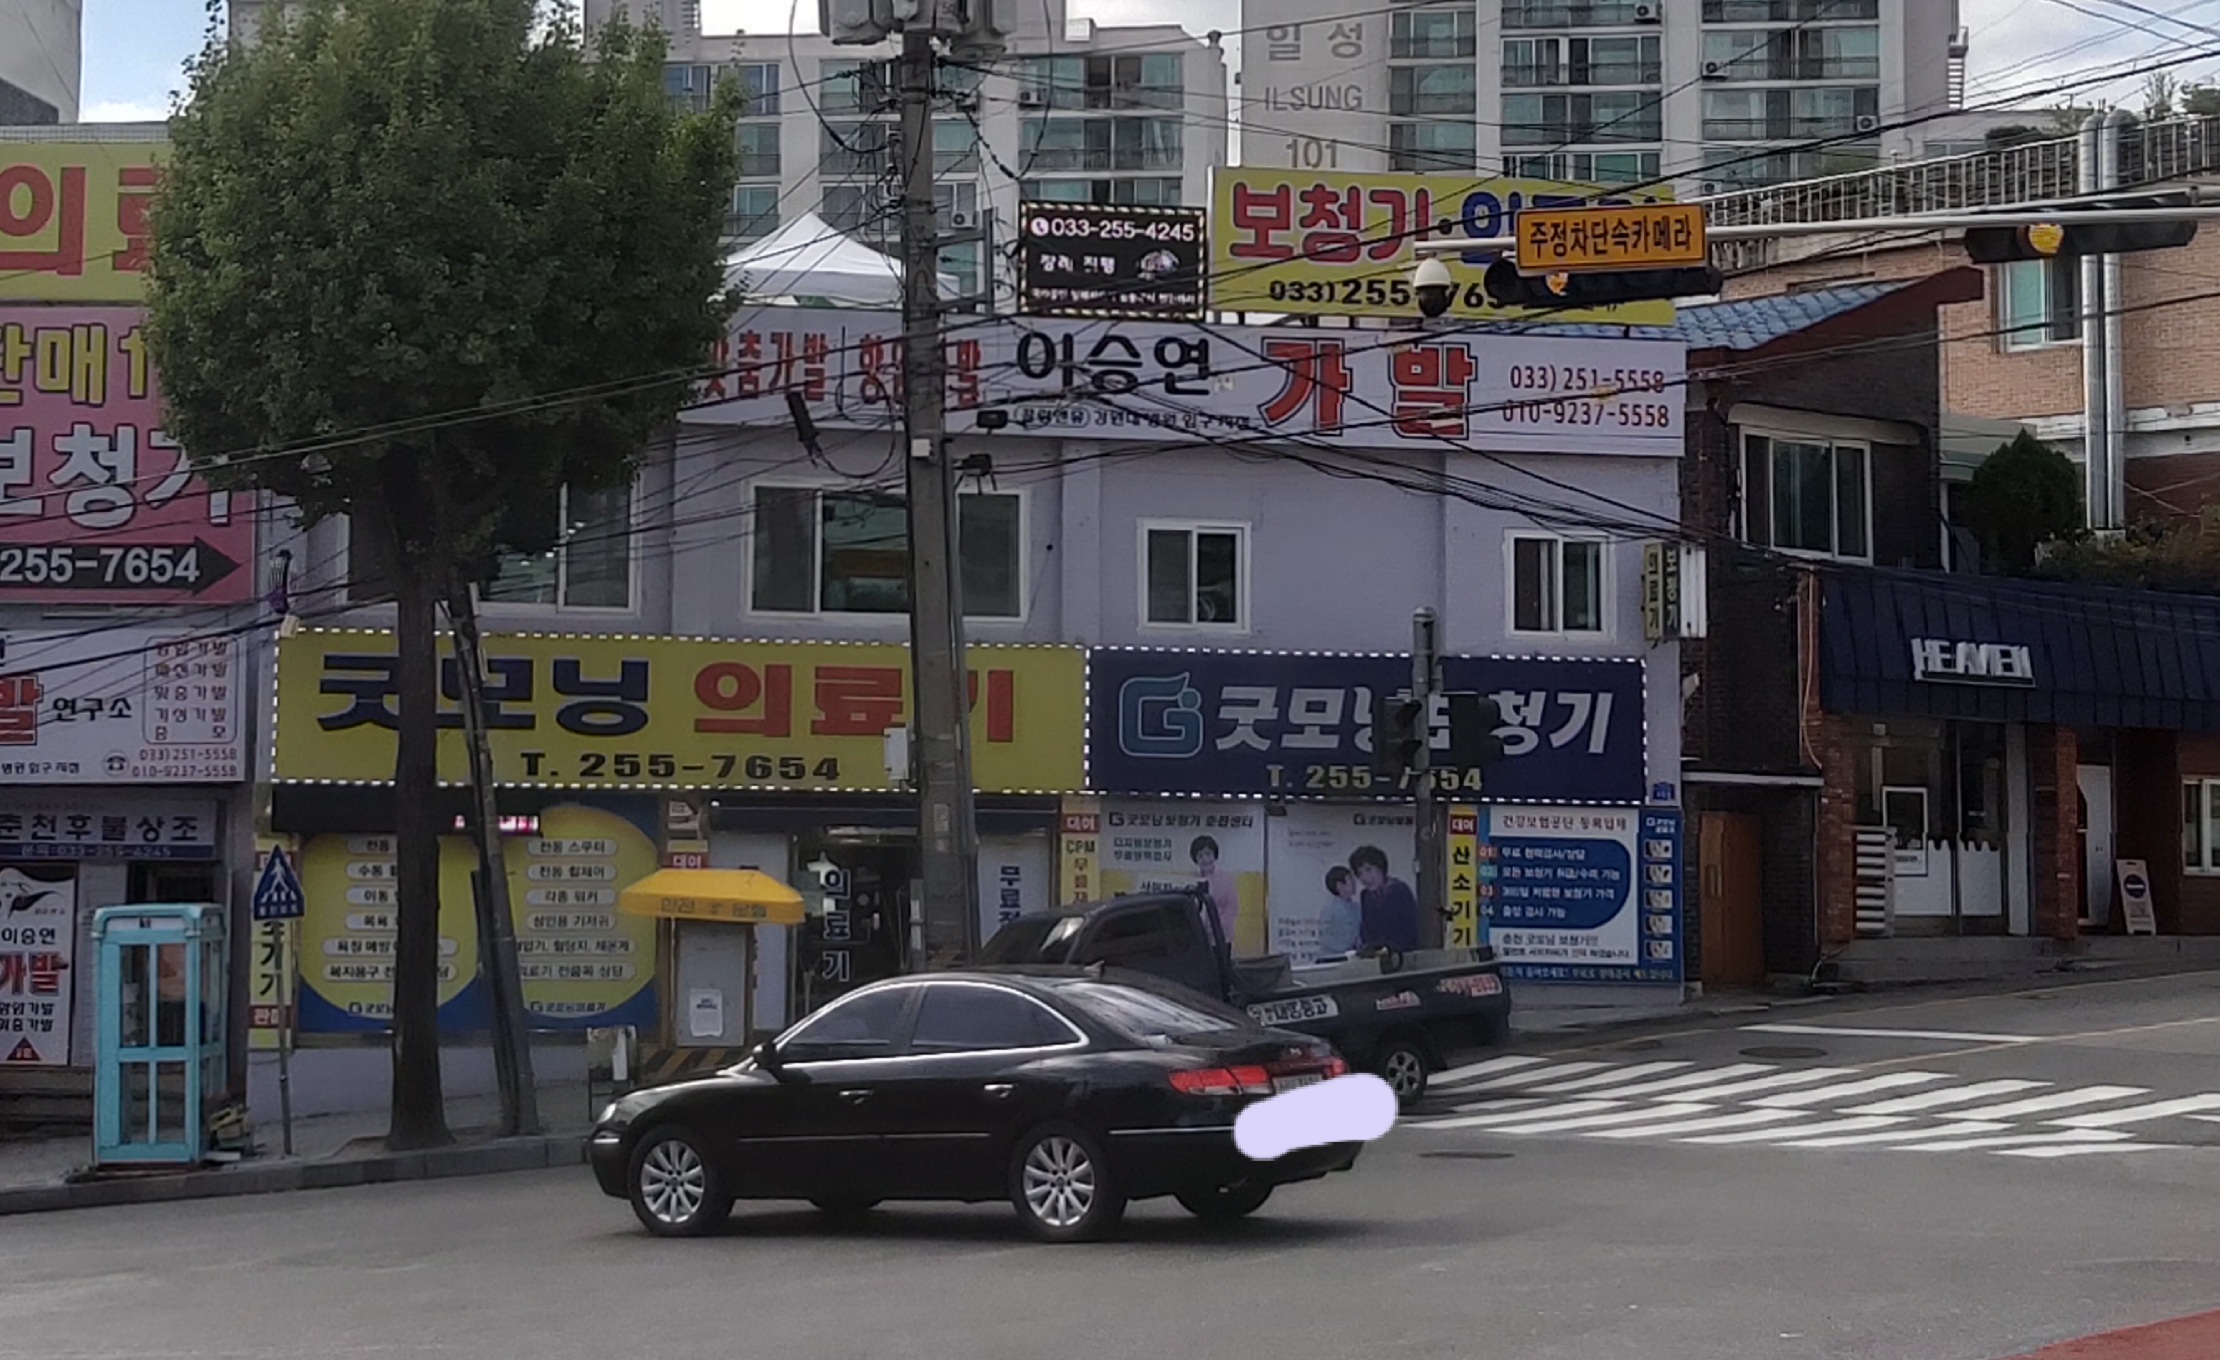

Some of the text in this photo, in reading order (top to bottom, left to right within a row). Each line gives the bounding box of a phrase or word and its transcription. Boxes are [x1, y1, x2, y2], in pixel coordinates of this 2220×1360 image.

[1265, 85, 1362, 111] ILSUNG
[1286, 138, 1337, 168] 101
[1051, 218, 1195, 242] 033-255-4245
[1529, 215, 1692, 259] 주정차단속카메라
[1017, 330, 1212, 396] 이승연
[1257, 336, 1478, 441] 가발
[1510, 364, 1666, 393] 033)251-5558
[1502, 400, 1670, 428] 010-9237-5558
[0, 547, 200, 584] 255-7654
[52, 697, 133, 723] 연구소
[316, 653, 650, 737] 굿모닝
[579, 752, 841, 782] 255-7654
[0, 812, 199, 843] 춘천후불상조
[822, 869, 851, 983] 의료기
